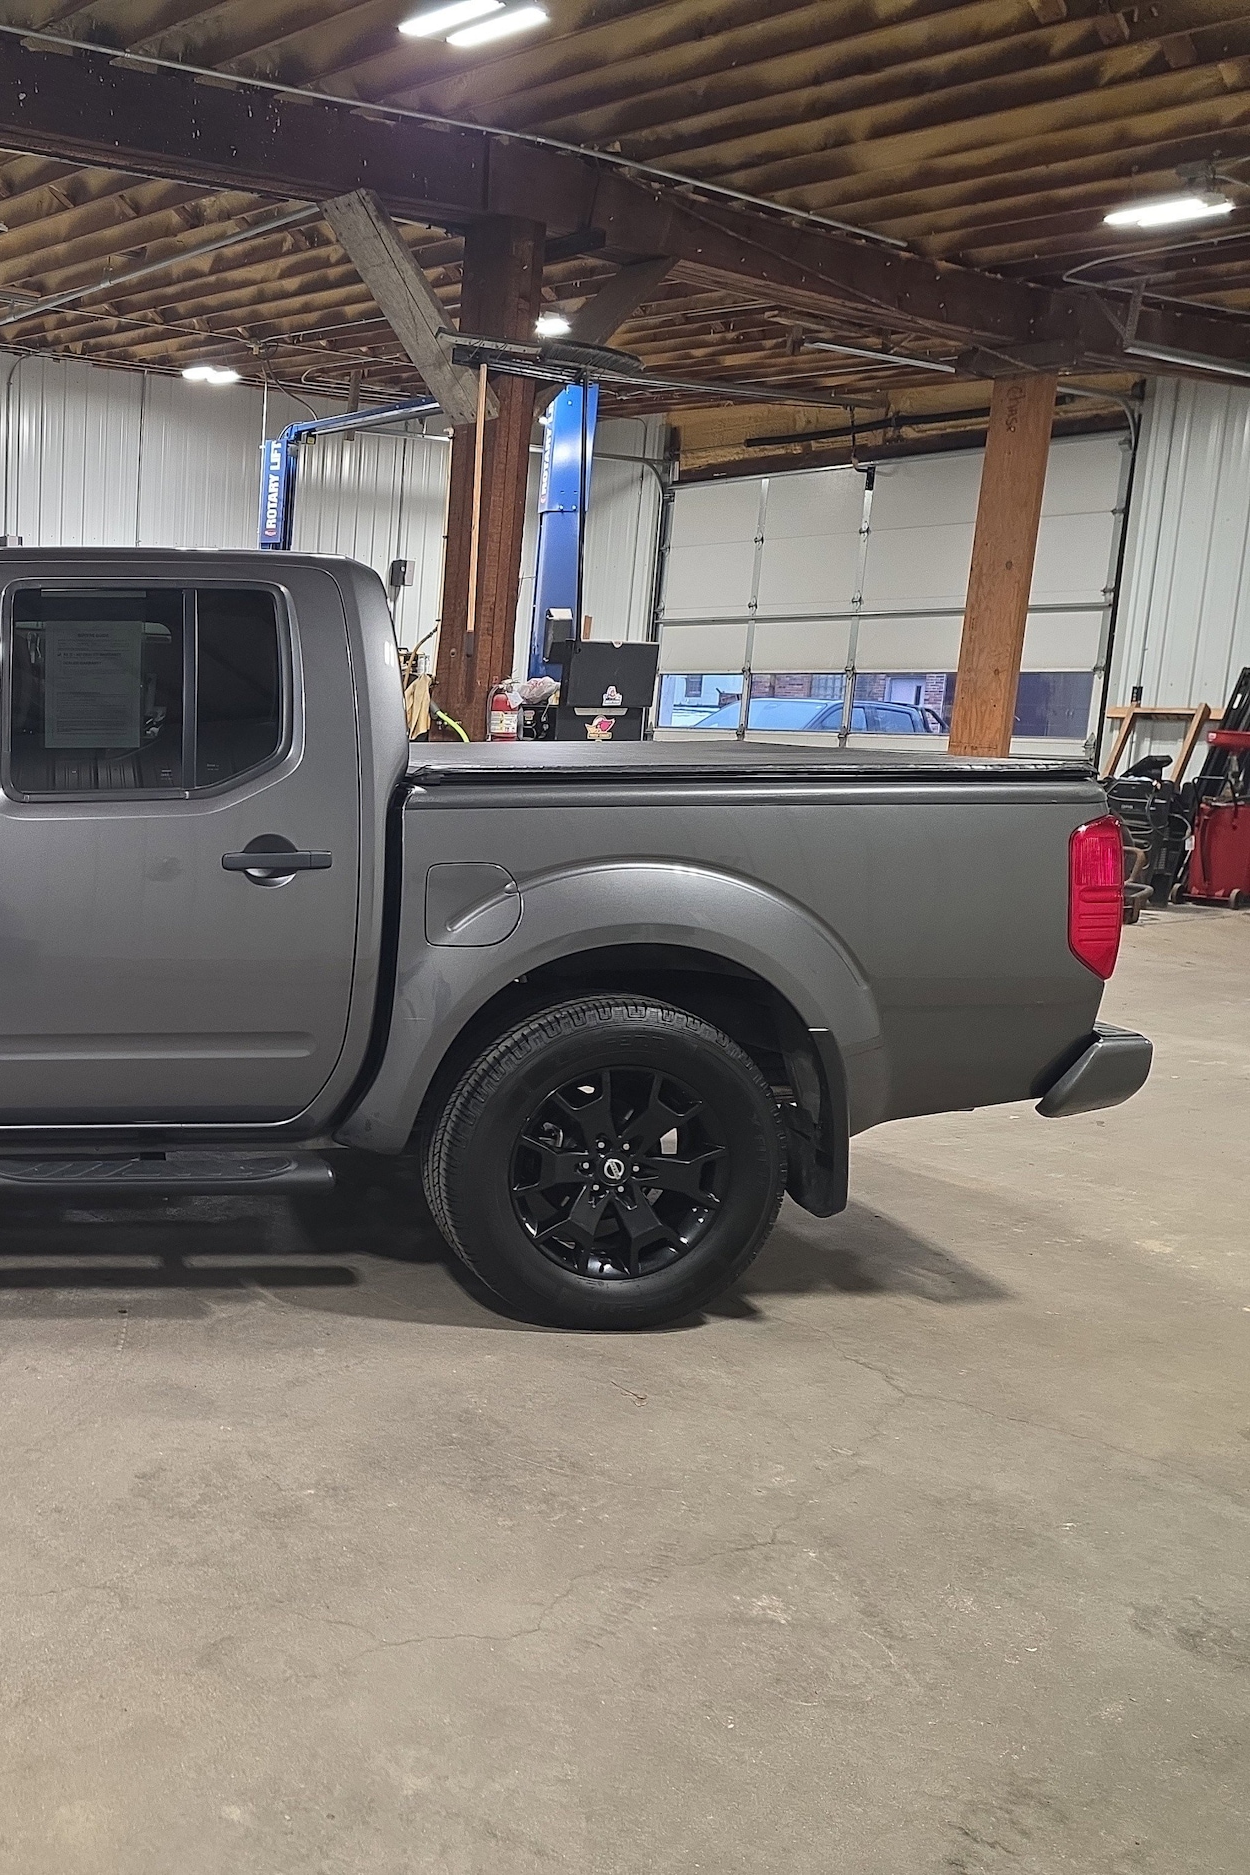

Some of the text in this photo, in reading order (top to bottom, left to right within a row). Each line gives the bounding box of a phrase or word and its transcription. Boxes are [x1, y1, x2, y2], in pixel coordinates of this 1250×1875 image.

[266, 440, 282, 529] ROTARY LIFT
[541, 428, 552, 495] ROTARY
